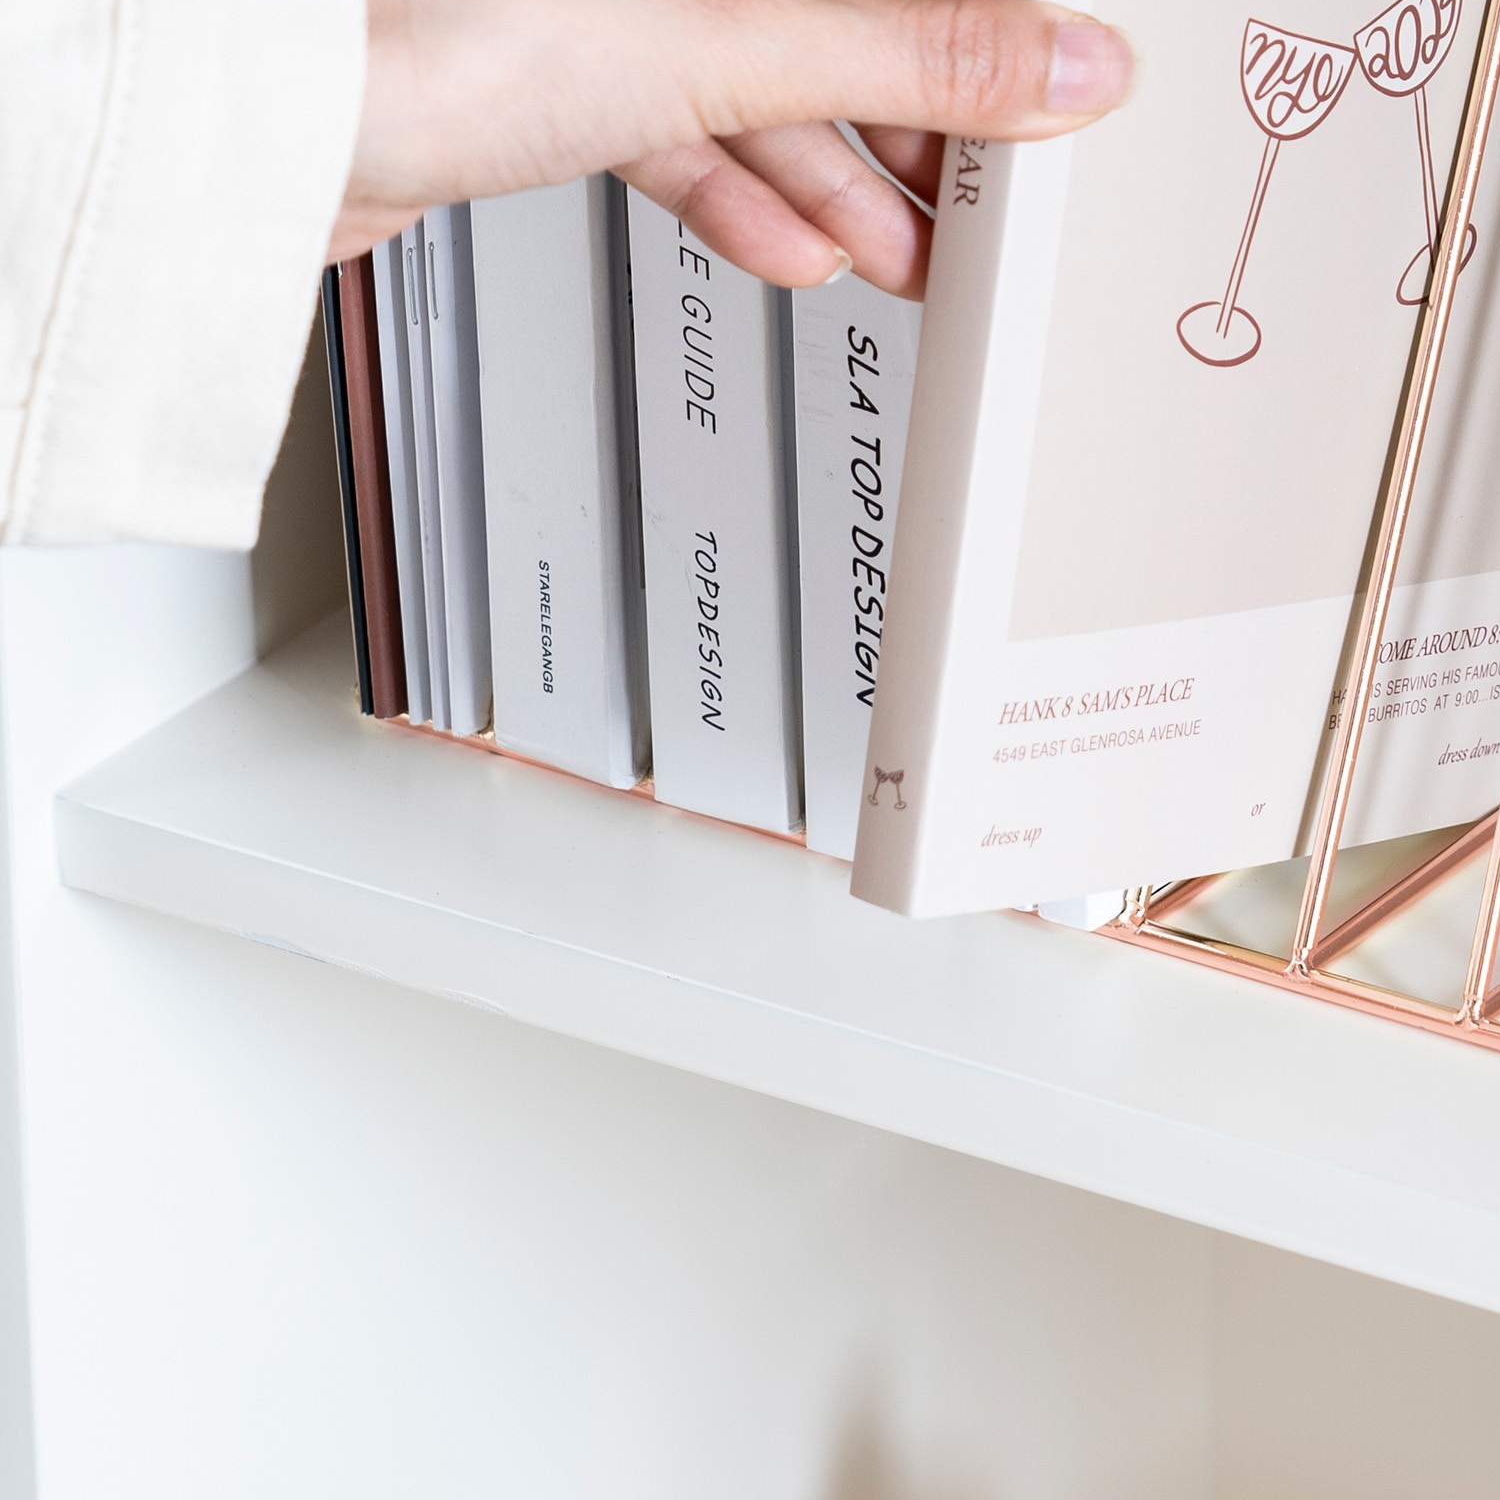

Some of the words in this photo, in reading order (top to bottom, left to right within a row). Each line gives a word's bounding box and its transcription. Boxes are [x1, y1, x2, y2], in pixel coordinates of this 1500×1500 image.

[681, 294, 717, 435] GUIDE
[847, 325, 880, 416] SLA
[1416, 626, 1488, 657] AROUND
[1386, 672, 1438, 696] SERVING
[1441, 668, 1461, 686] HIS
[998, 697, 1061, 725] HANK
[1077, 686, 1134, 716] SAM'S
[1134, 677, 1195, 708] PLACE
[1368, 698, 1428, 723] BURRITOS
[1433, 694, 1450, 711] AT
[993, 745, 1027, 764] 4549
[1030, 739, 1067, 759] EAST
[1070, 729, 1145, 754] GLENROSA
[1148, 719, 1202, 742] AVENUE
[1437, 743, 1468, 765] dress
[1470, 737, 1500, 760] down
[1250, 800, 1265, 816] or
[981, 824, 1020, 848] dress
[1023, 826, 1043, 848] up
